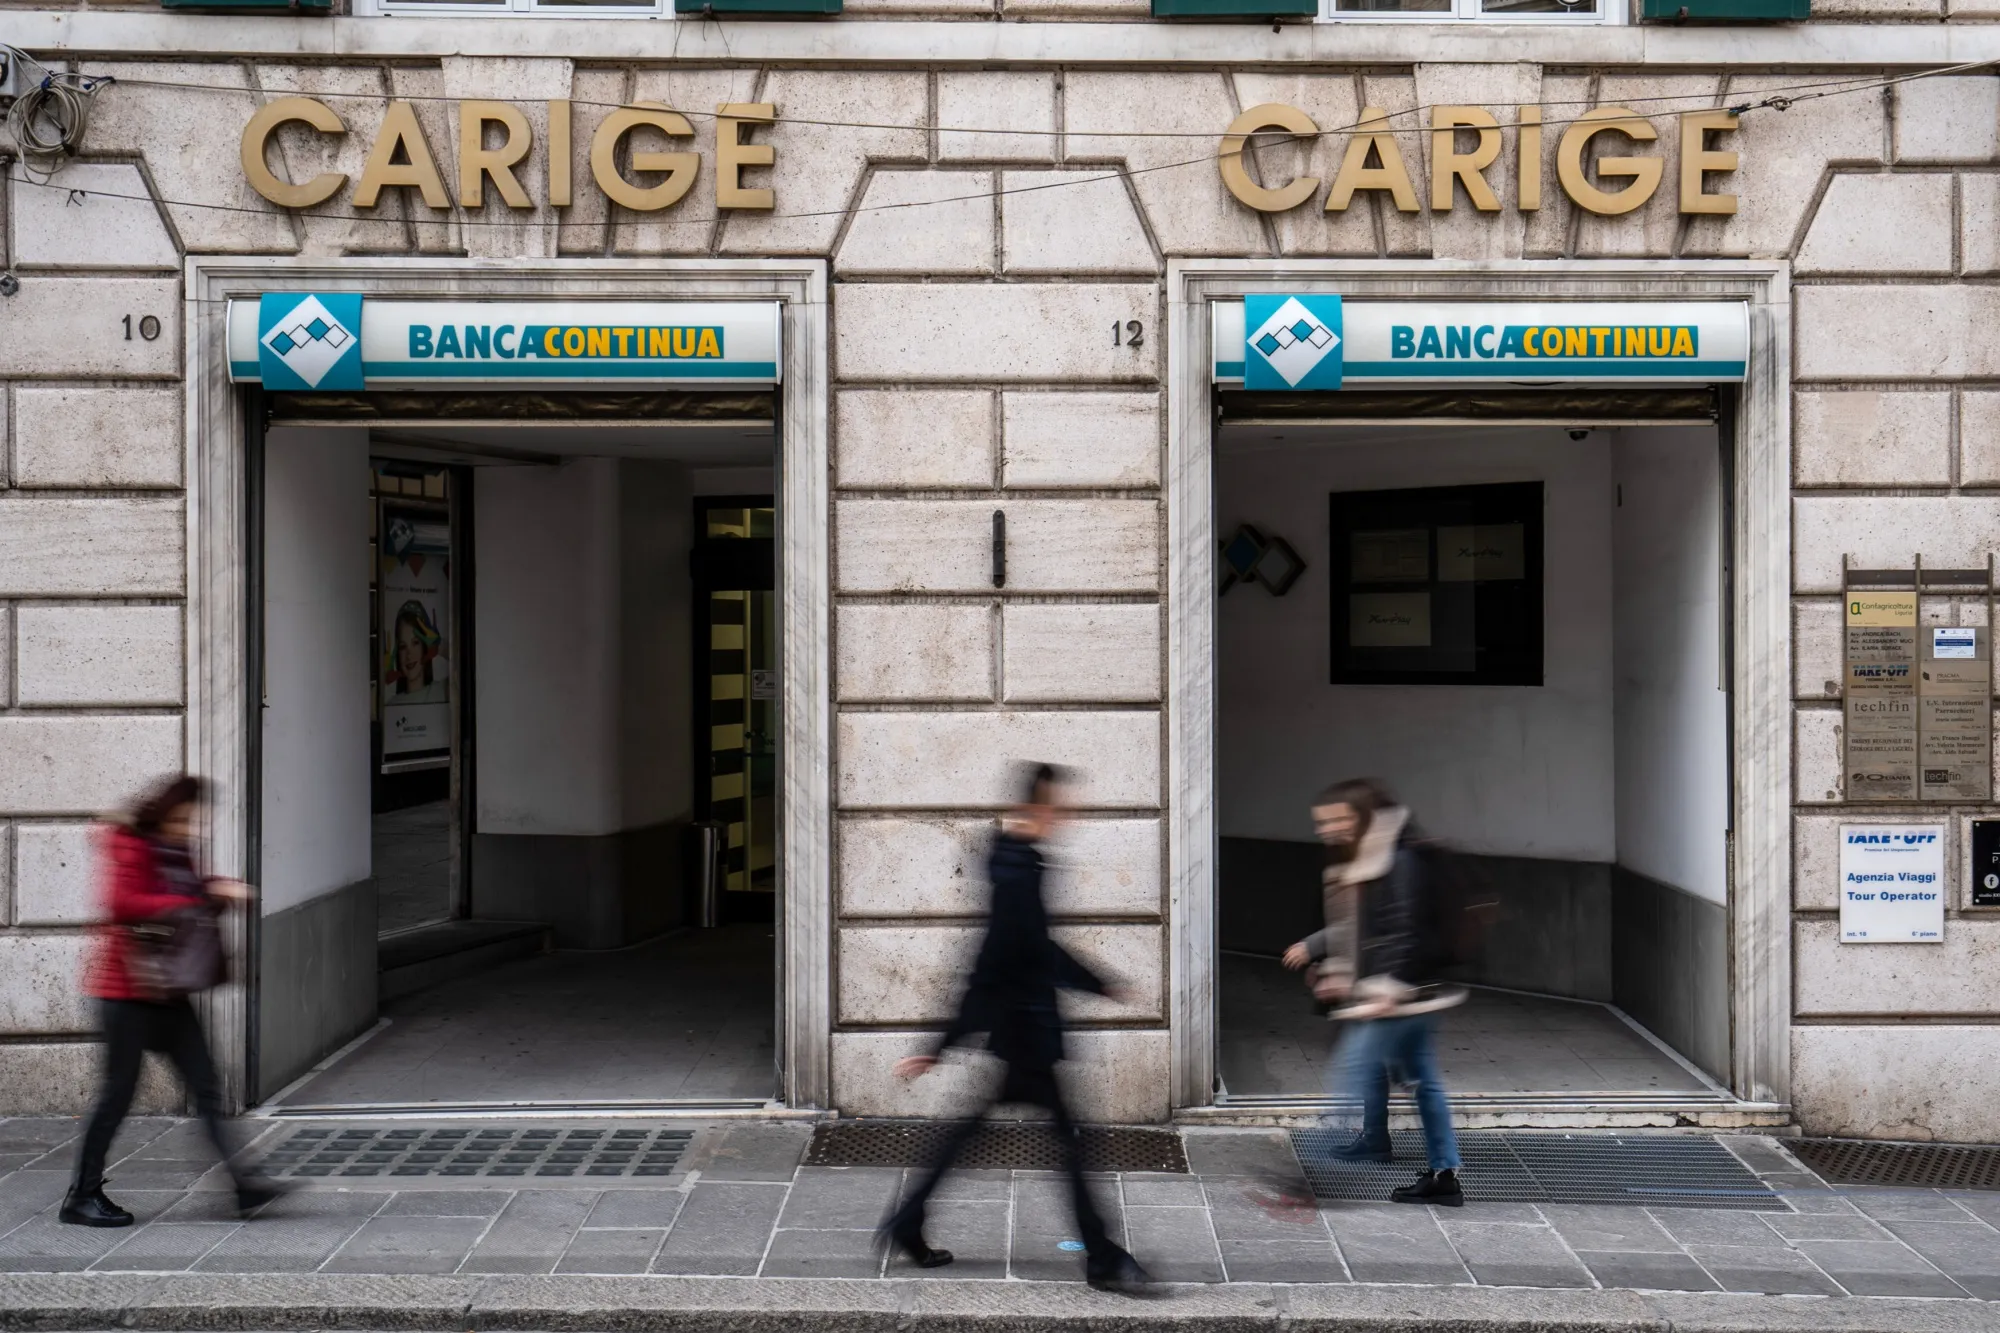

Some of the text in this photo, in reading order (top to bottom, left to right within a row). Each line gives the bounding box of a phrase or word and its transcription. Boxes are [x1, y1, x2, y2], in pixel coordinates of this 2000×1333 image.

[240, 97, 774, 210] CARIGE
[1218, 103, 1738, 216] CARIGE
[122, 314, 161, 341] 10
[1112, 320, 1145, 346] 12
[409, 325, 722, 359] BANCA CONTINUA
[1391, 325, 1696, 359] BANCA CONTINUA
[1862, 602, 1913, 610] Confagricoltura
[1854, 700, 1909, 712] techfin
[1926, 771, 1961, 781] techfin
[1847, 873, 1936, 883] Agenzia Viaggi
[1847, 892, 1937, 903] Tour Operator
